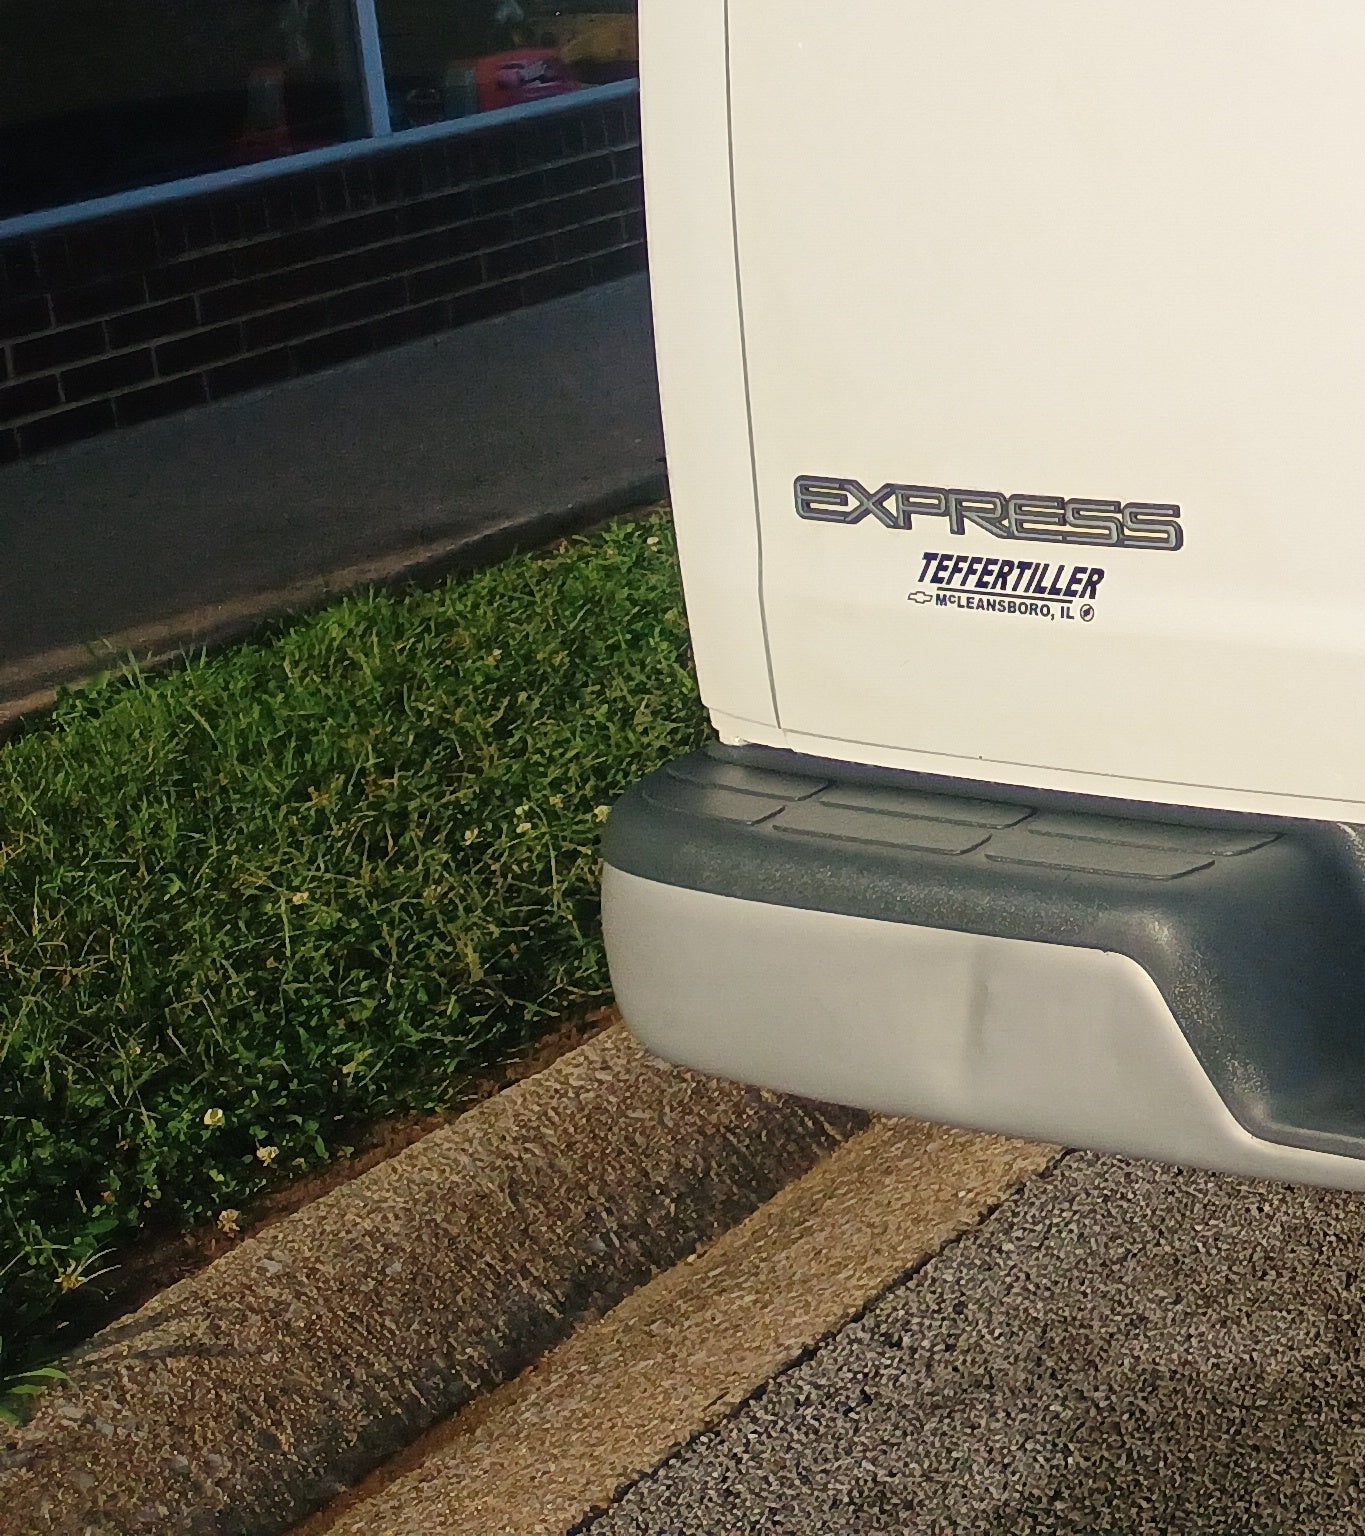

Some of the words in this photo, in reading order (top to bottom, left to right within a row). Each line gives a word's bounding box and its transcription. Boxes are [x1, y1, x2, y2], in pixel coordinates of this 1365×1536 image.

[794, 475, 1184, 551] EXPRESS
[918, 552, 1105, 599] TEFFERTILLER
[1060, 606, 1075, 620] IL
